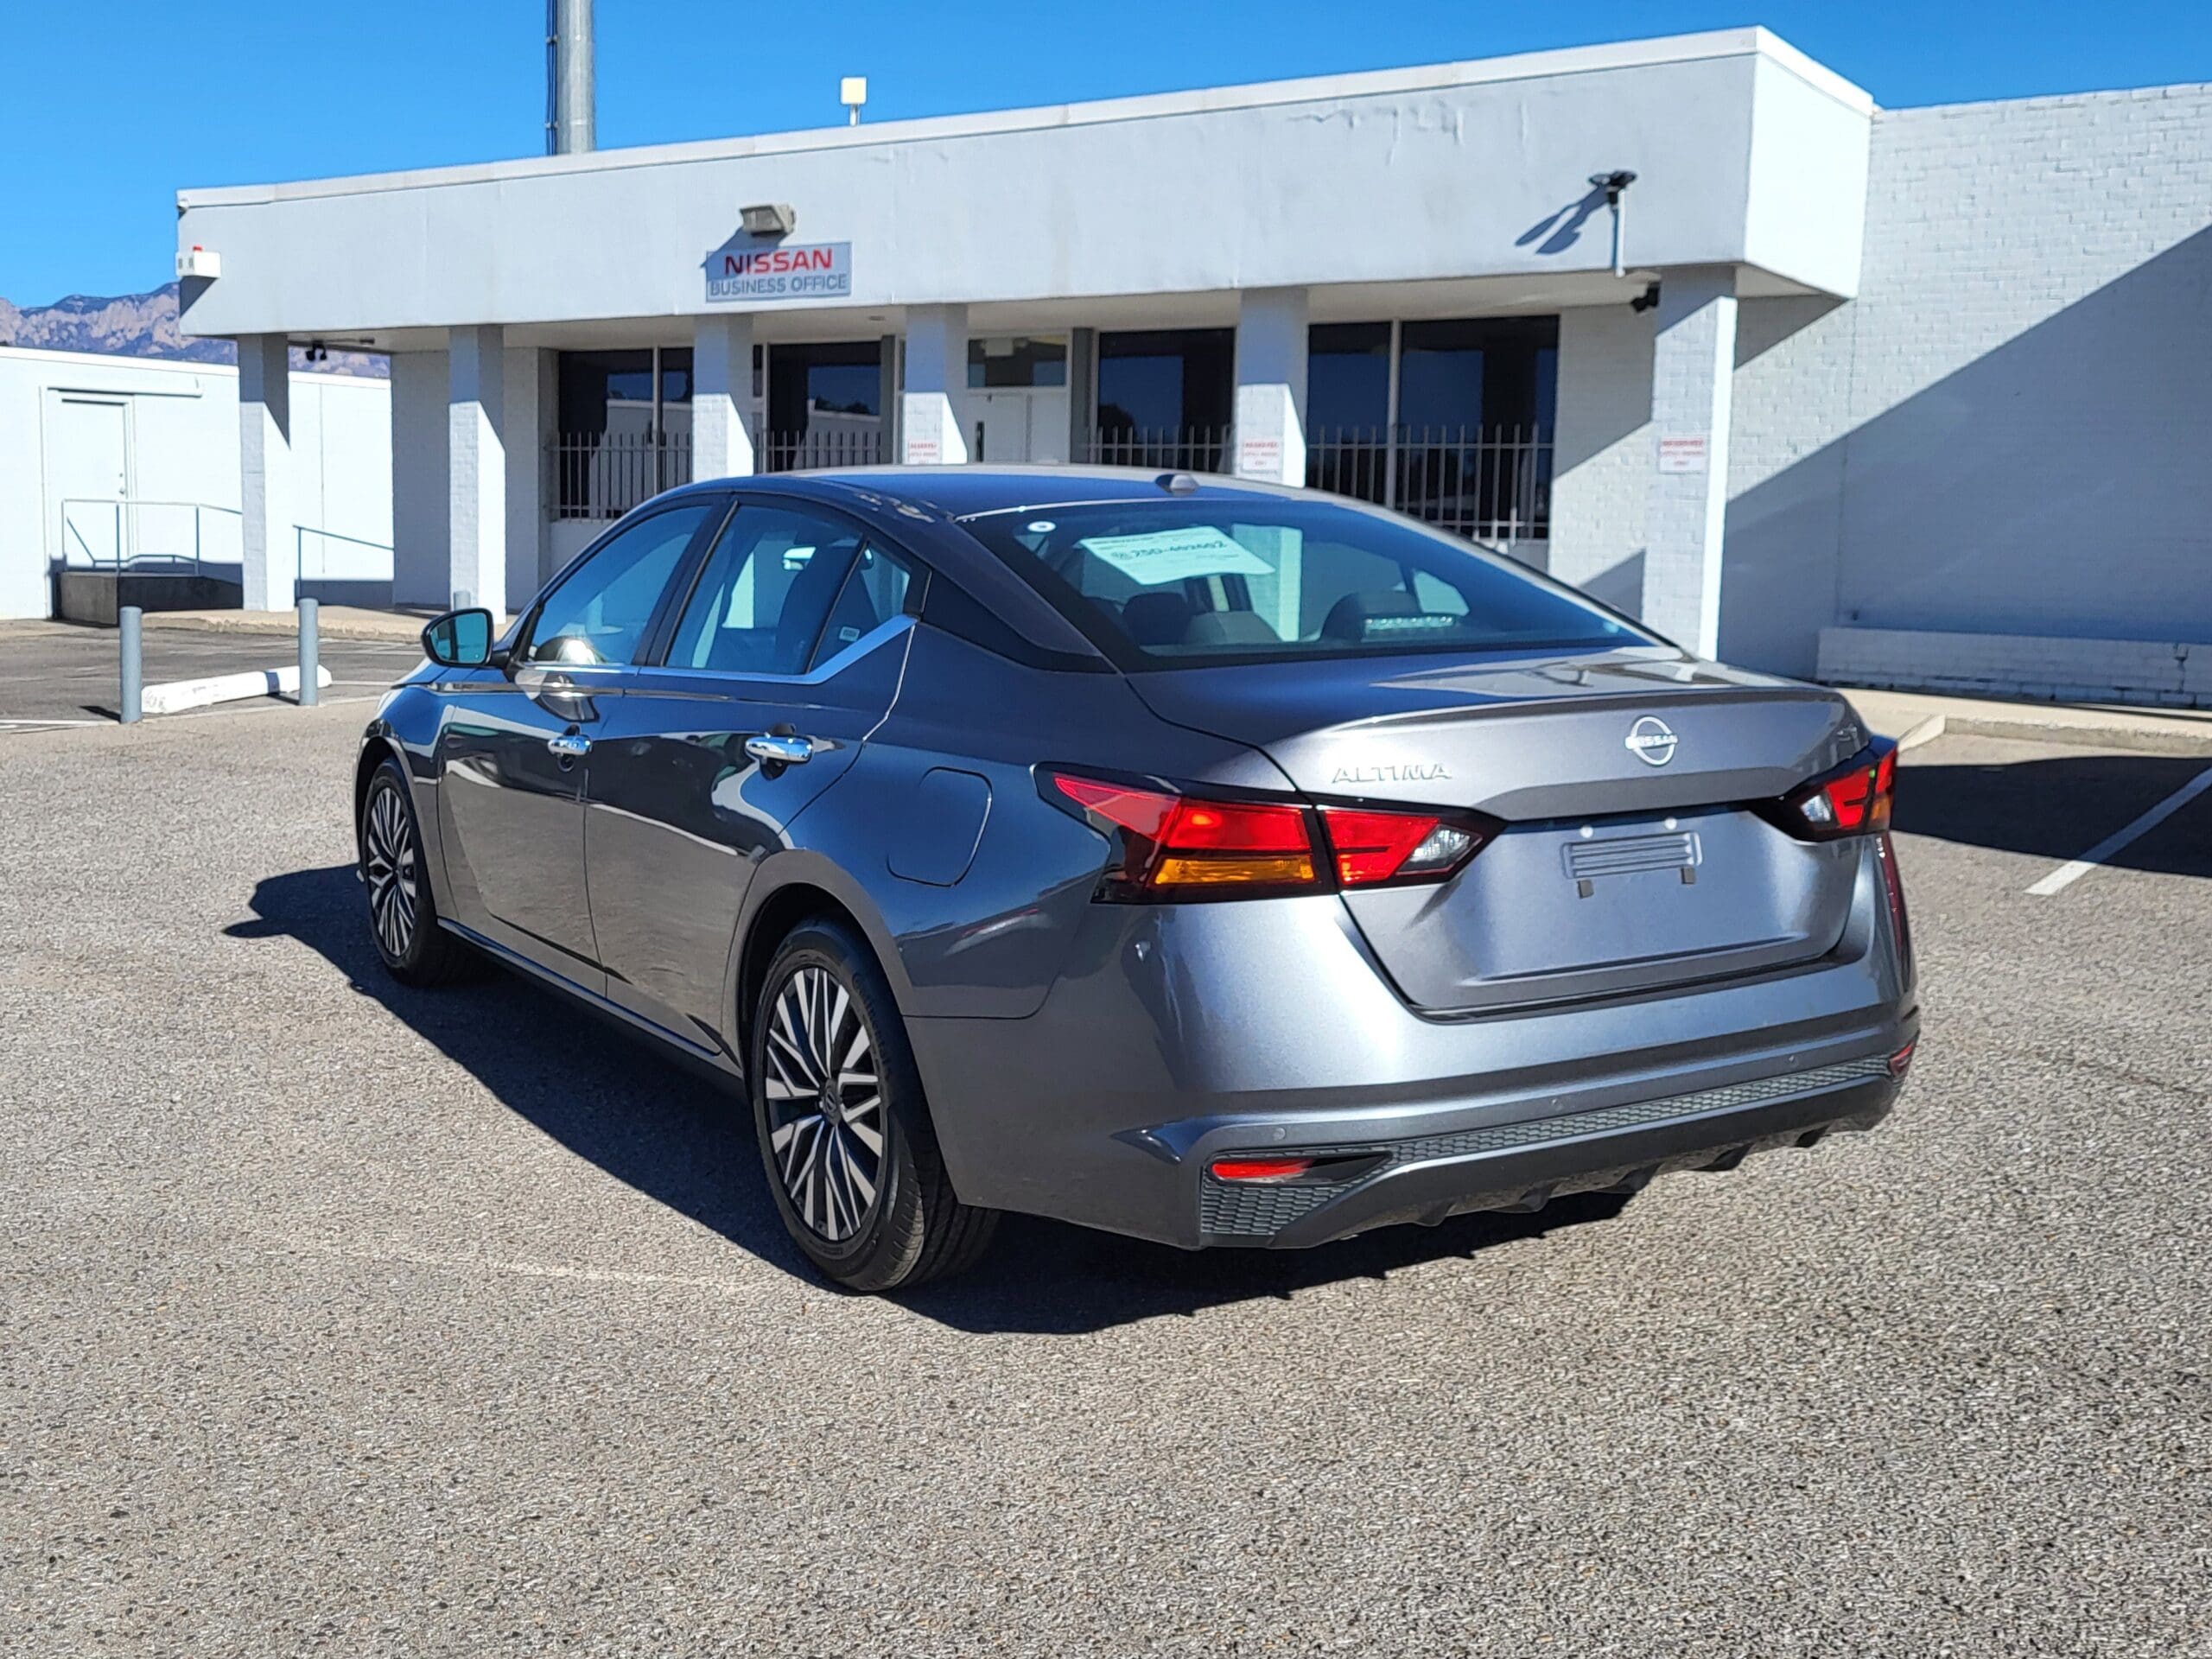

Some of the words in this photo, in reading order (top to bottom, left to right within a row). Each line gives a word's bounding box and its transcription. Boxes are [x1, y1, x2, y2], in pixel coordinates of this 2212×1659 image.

[725, 247, 832, 275] NISSAN
[710, 276, 786, 296] BUSINESS
[791, 273, 847, 292] OFFICE
[1332, 763, 1452, 784] ALTIMA
